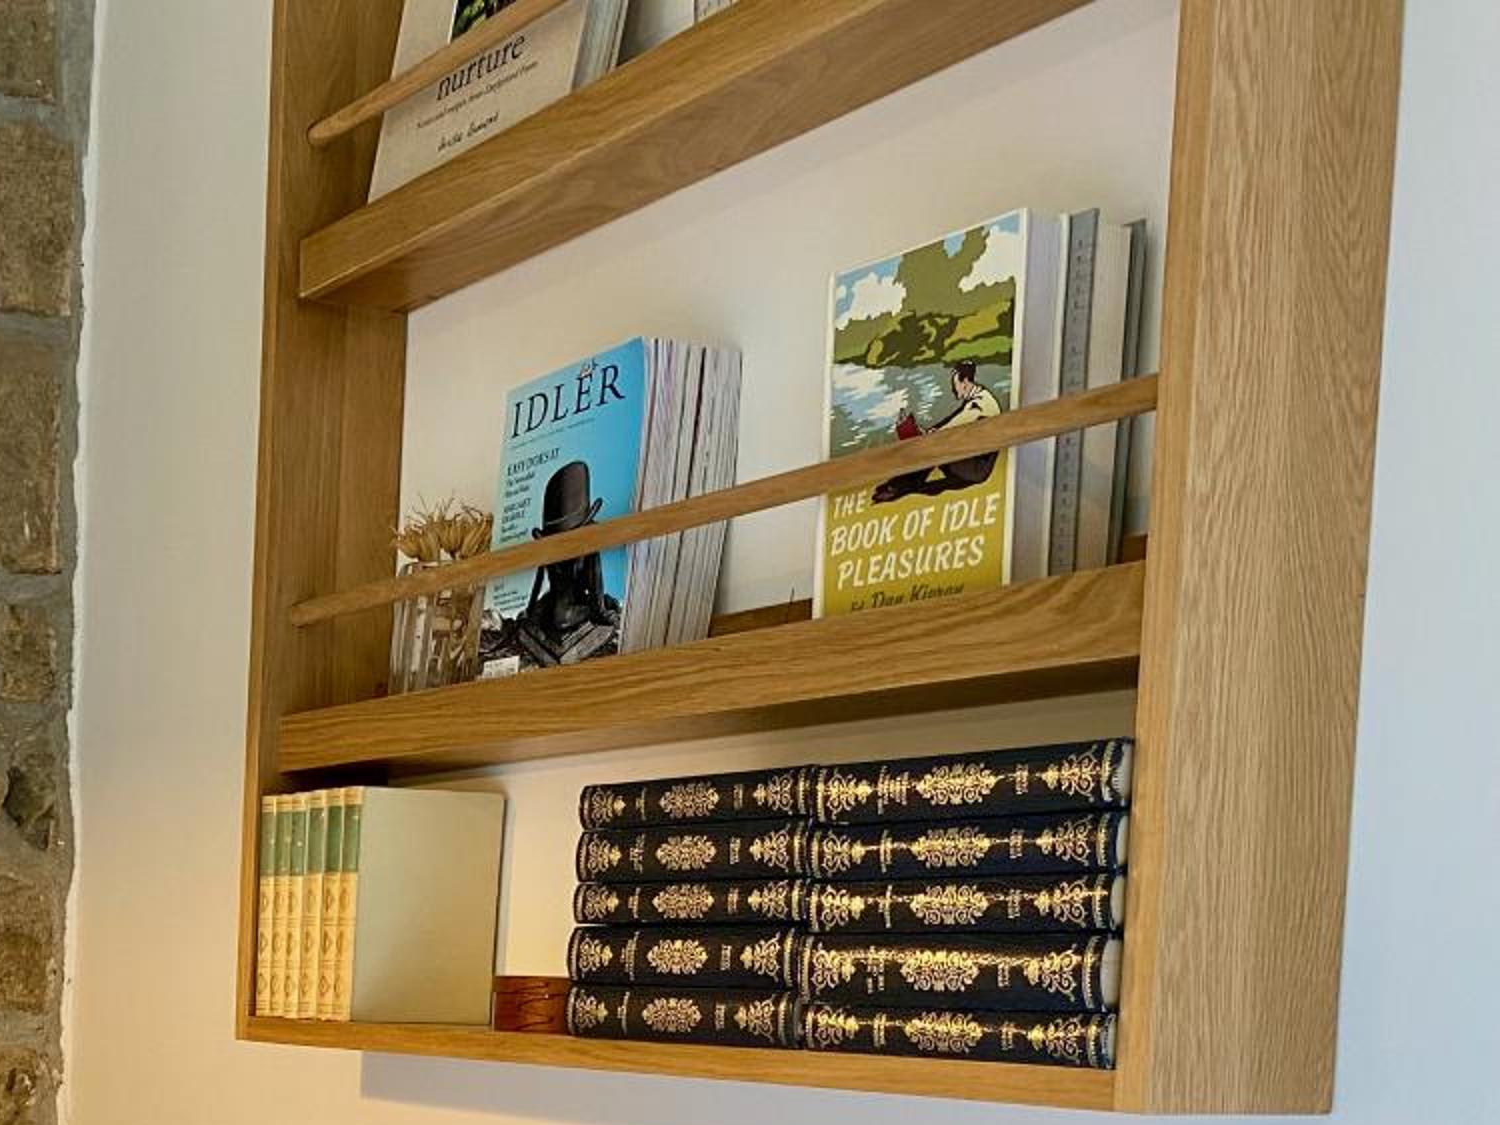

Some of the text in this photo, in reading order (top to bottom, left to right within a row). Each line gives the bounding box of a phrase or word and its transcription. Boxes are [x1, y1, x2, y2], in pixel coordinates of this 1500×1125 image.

[436, 34, 525, 100] nurture
[511, 364, 626, 439] IDLER
[831, 493, 1000, 557] BOOK OF IDLE
[833, 490, 867, 520] THE
[837, 534, 985, 591] PLEASURES
